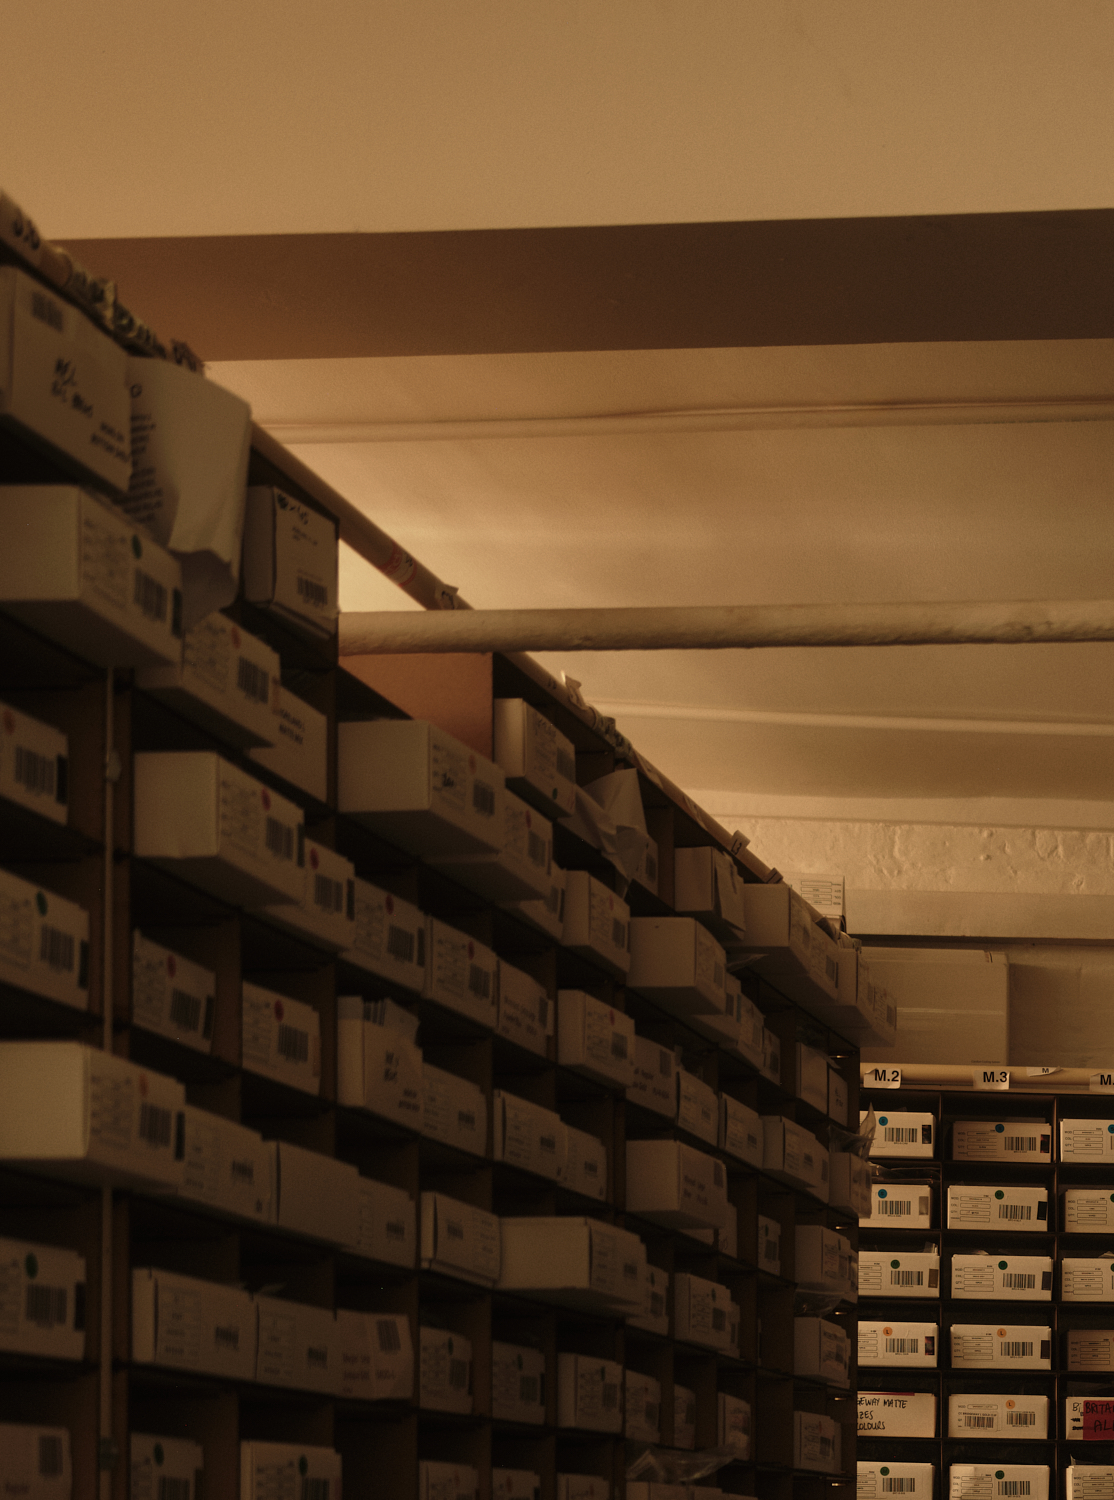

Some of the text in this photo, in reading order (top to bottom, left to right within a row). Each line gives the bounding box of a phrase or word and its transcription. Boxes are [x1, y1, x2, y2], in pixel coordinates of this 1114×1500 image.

[874, 1069, 900, 1082] M.2
[983, 1071, 1008, 1083] M.3
[884, 1399, 908, 1409] MATTE
